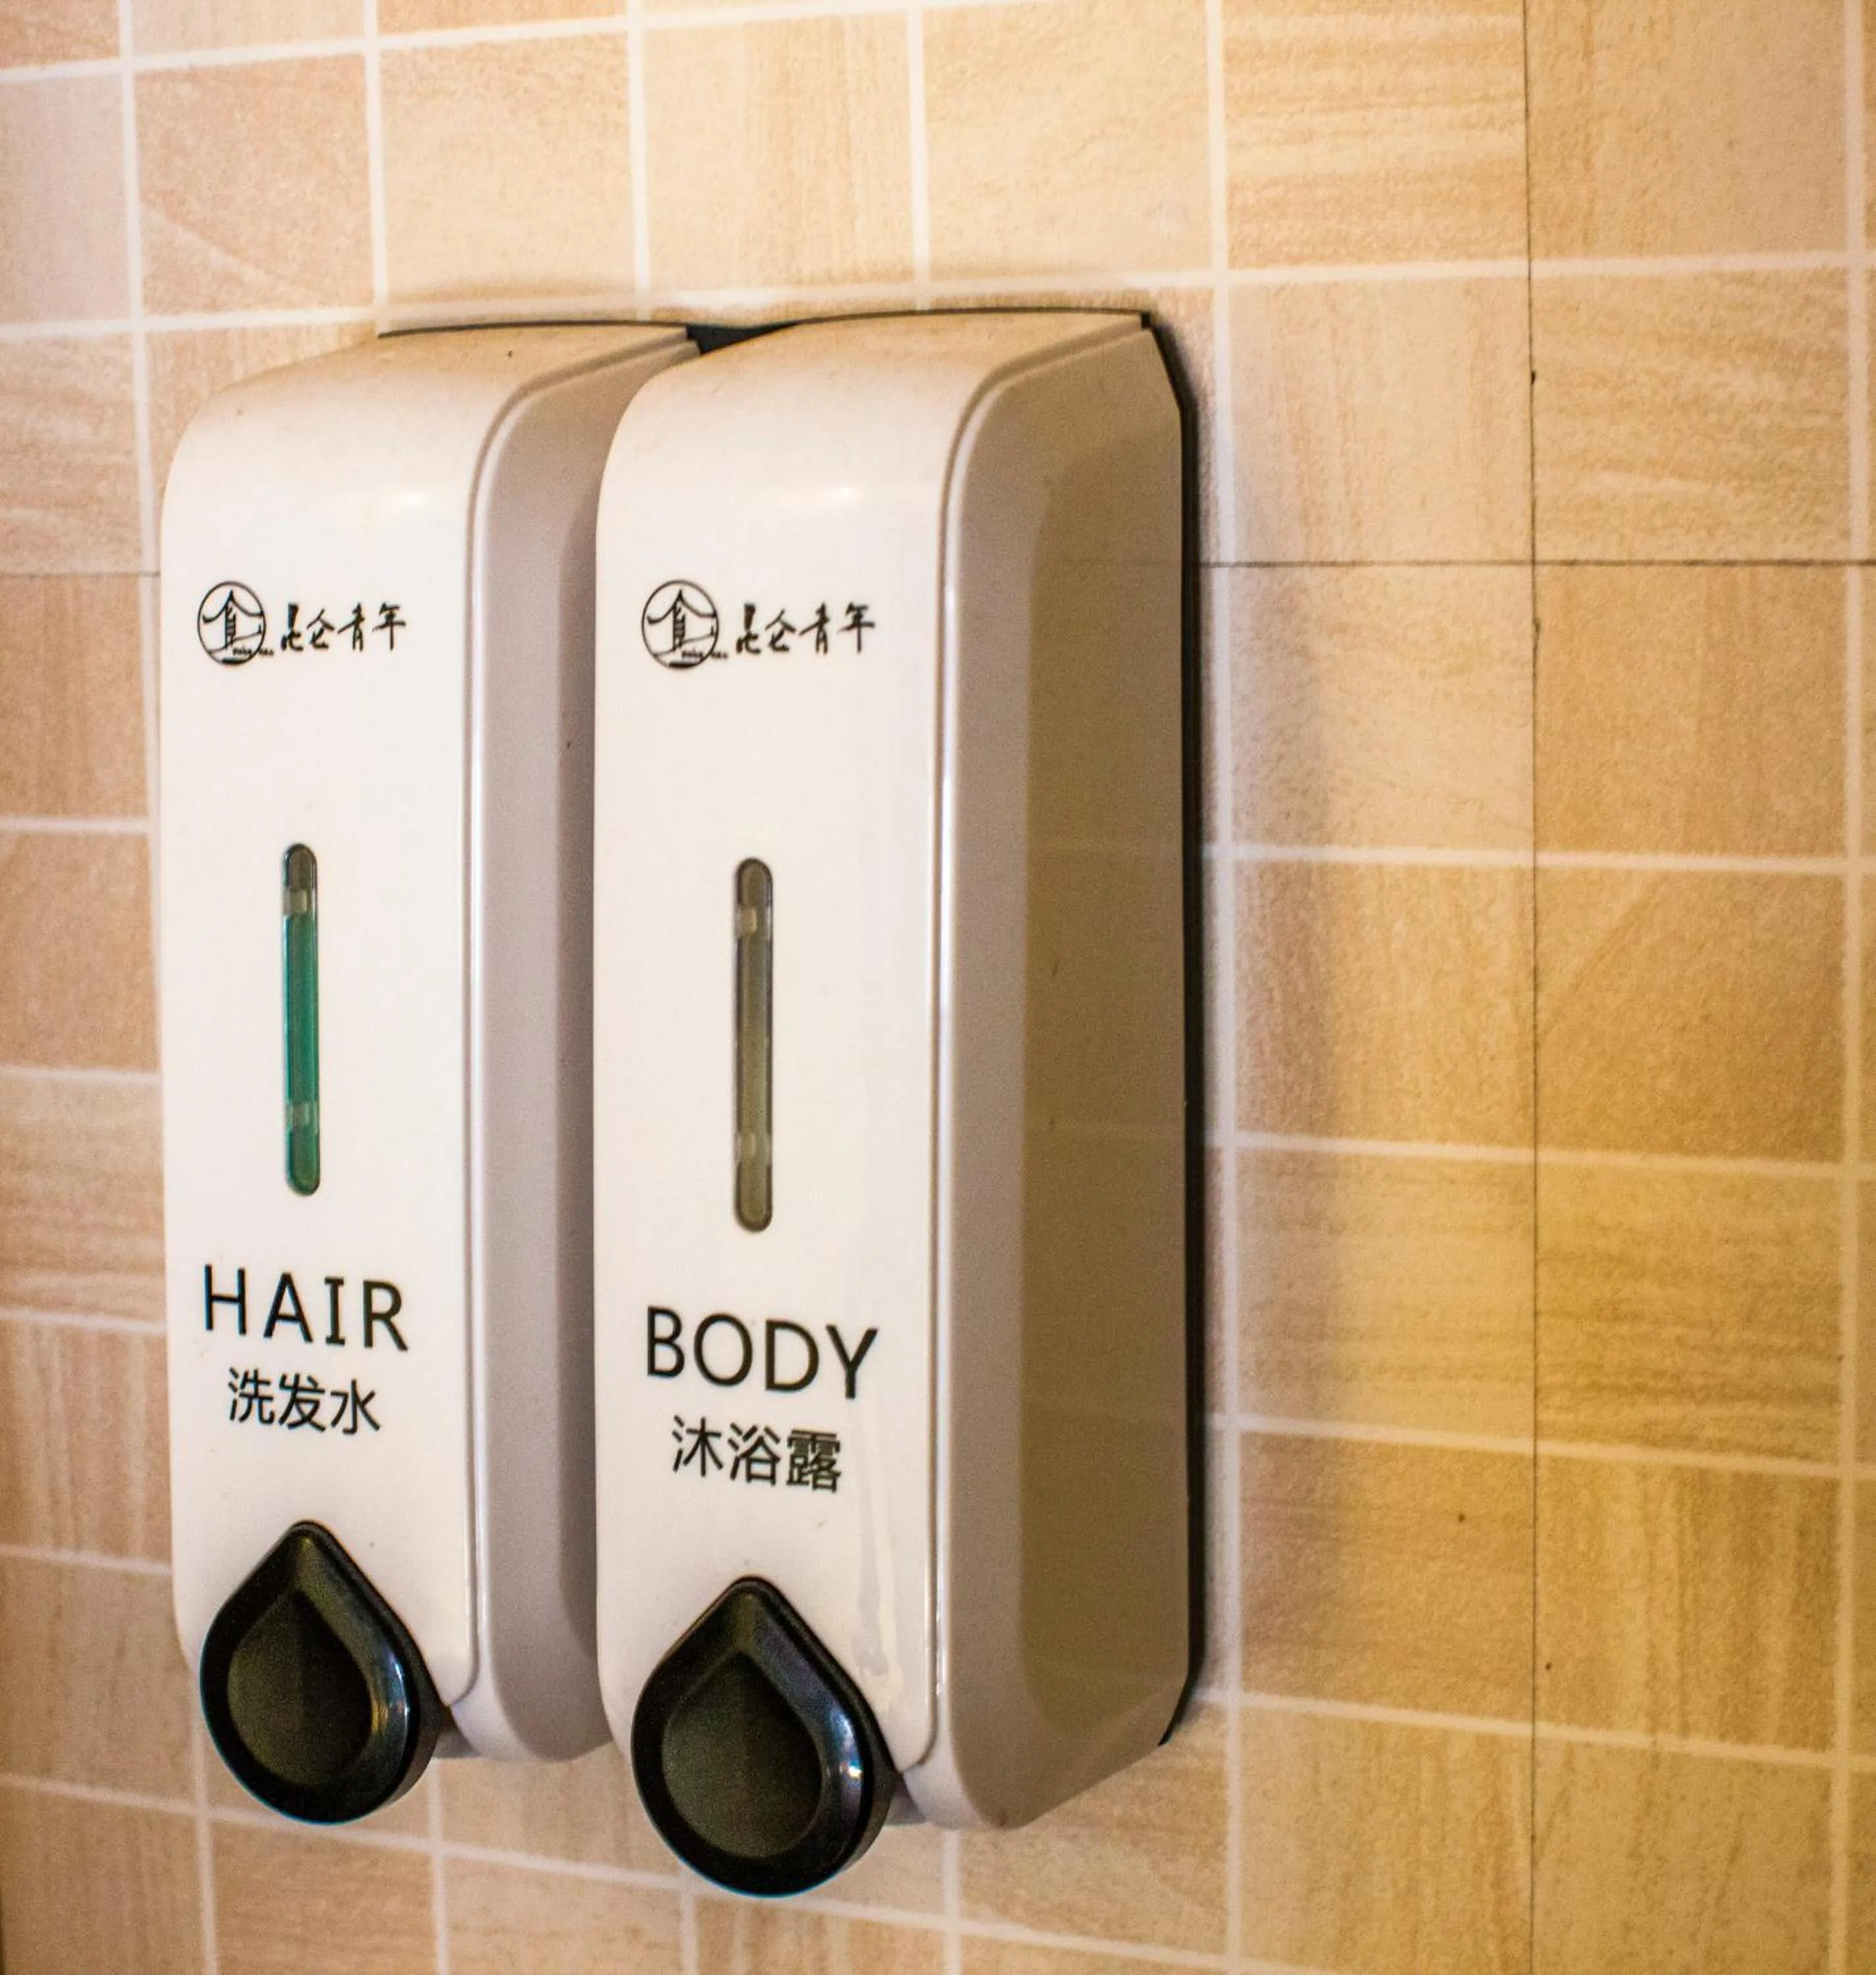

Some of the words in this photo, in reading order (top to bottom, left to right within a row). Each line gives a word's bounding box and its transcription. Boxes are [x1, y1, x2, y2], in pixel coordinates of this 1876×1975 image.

[204, 1263, 409, 1352] HAIR
[646, 1305, 879, 1400] BODY
[227, 1366, 380, 1435] 洗发水
[671, 1414, 842, 1492] 沐浴露
